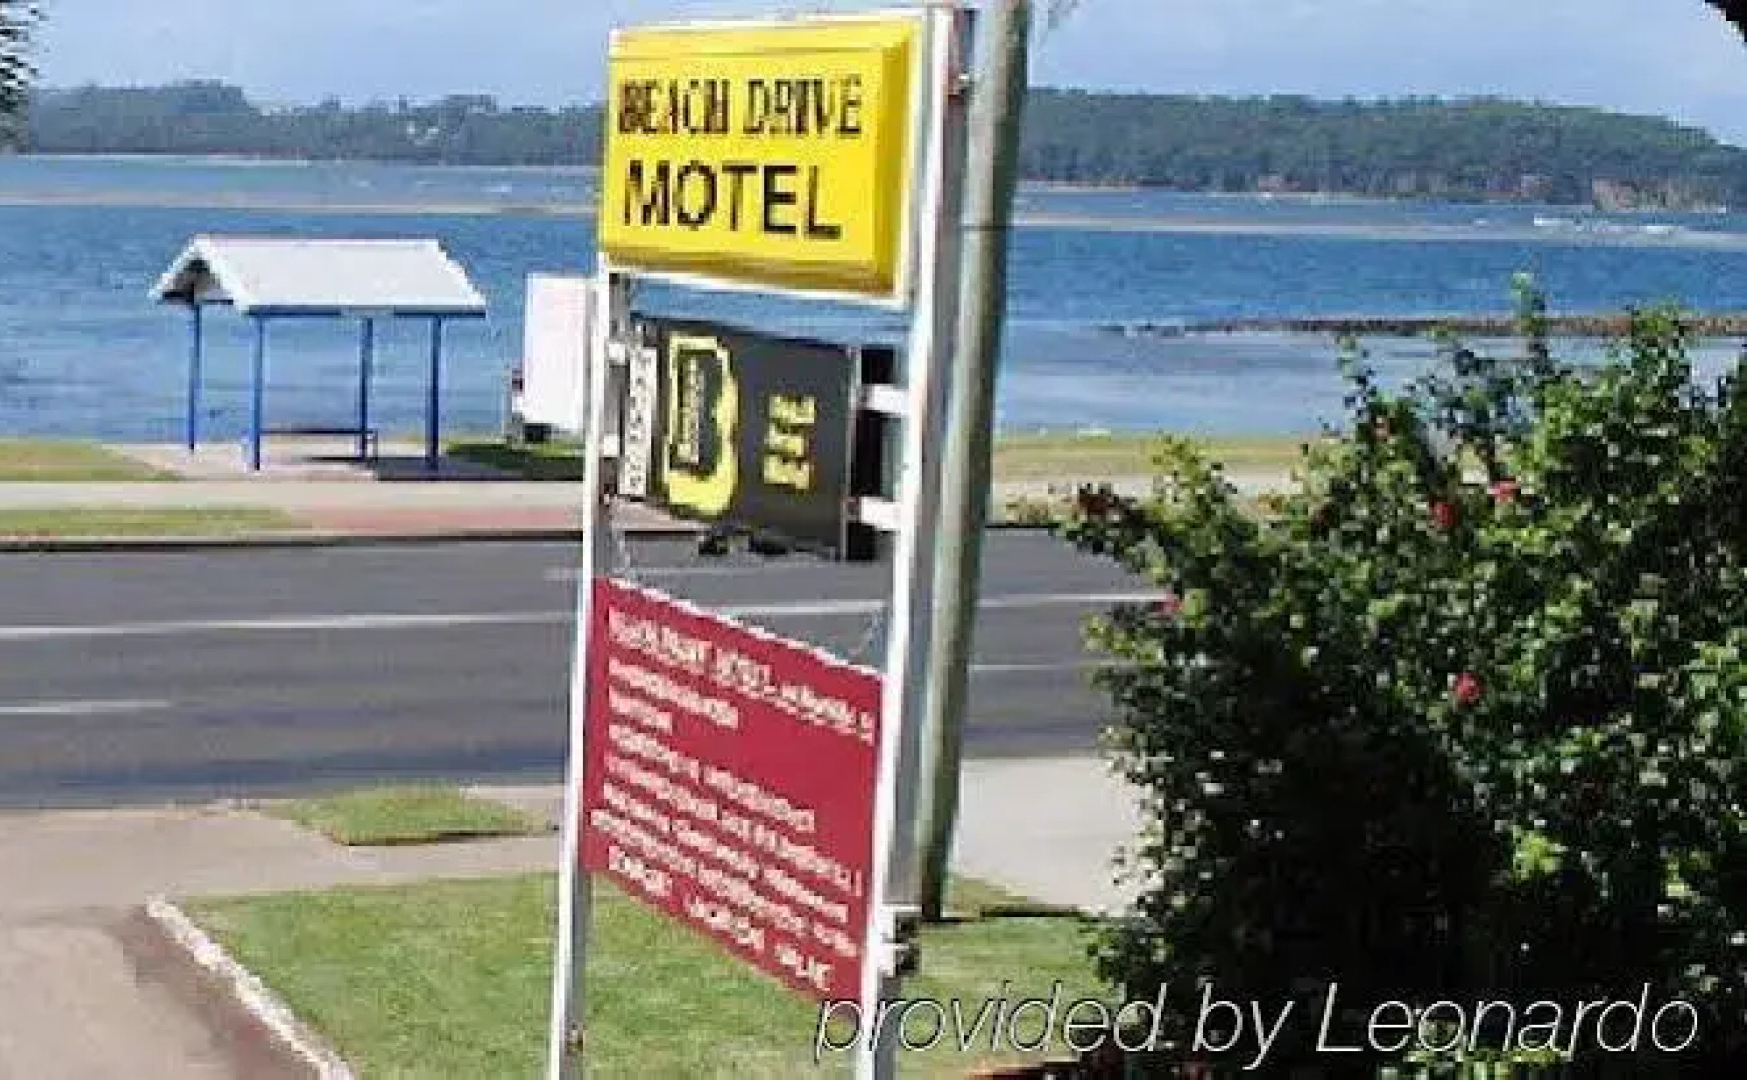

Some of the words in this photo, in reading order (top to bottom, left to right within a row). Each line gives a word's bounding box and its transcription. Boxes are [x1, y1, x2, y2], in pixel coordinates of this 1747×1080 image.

[618, 78, 730, 135] BEACH
[743, 74, 863, 137] DRIVE
[623, 160, 843, 240] MOTEL
